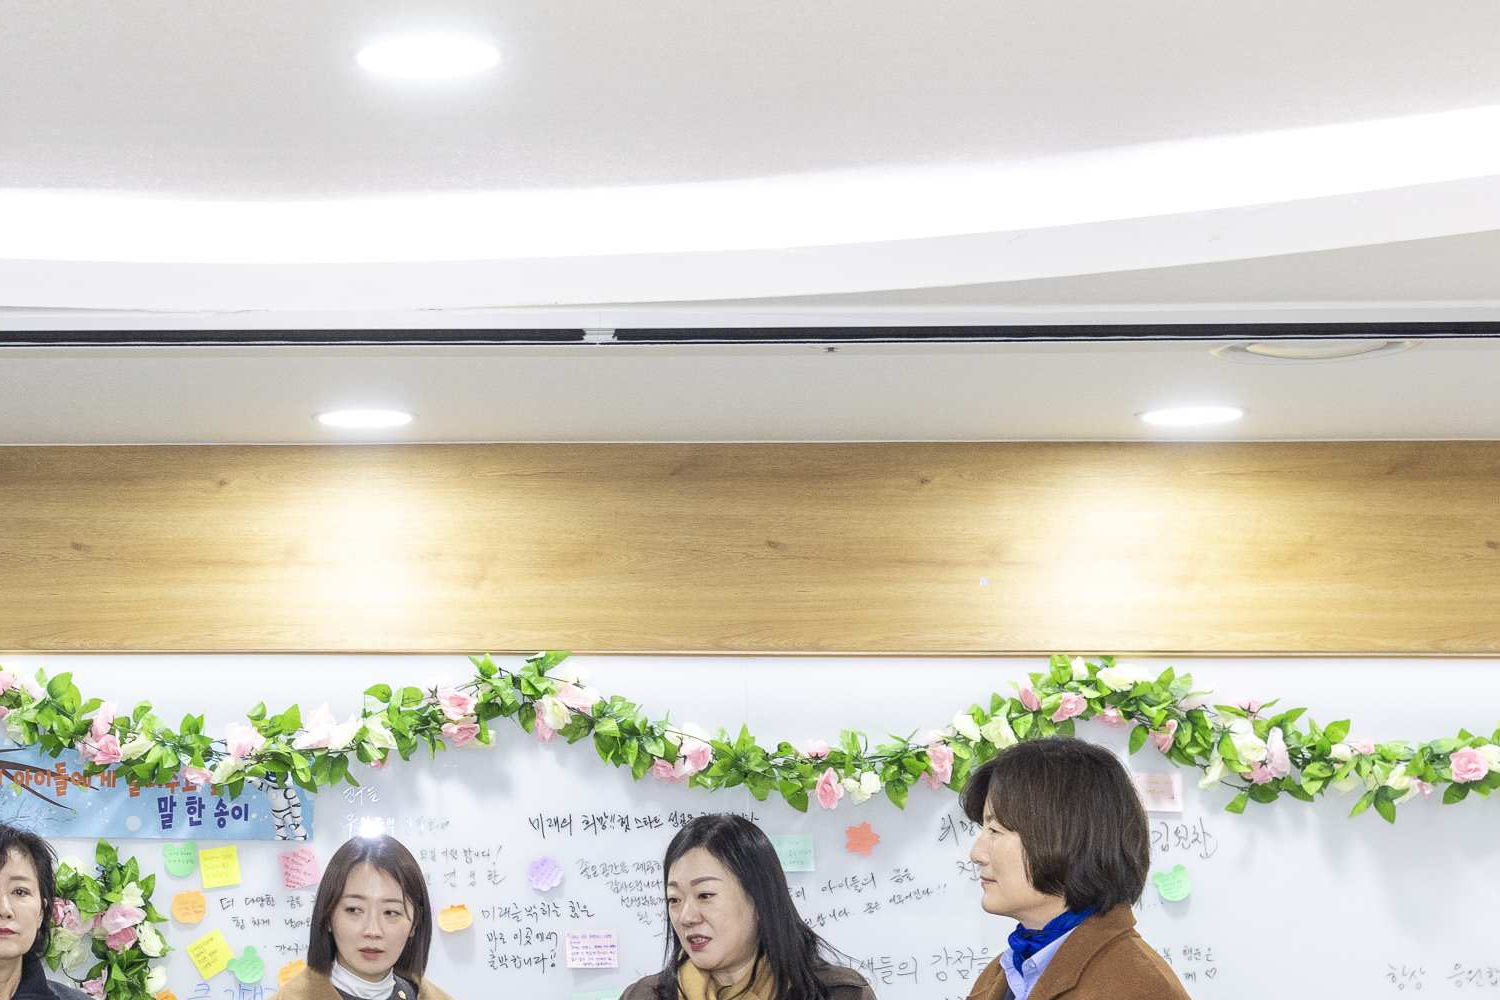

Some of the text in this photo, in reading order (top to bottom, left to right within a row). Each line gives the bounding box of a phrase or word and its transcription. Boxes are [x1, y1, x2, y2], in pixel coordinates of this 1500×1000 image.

[13, 762, 117, 797] 아이들에게
[157, 795, 249, 830] 말 한 송이
[821, 872, 877, 893] 아이들의
[890, 868, 916, 883] 꿈을
[244, 894, 277, 908] 다양한
[486, 930, 507, 952] 바로
